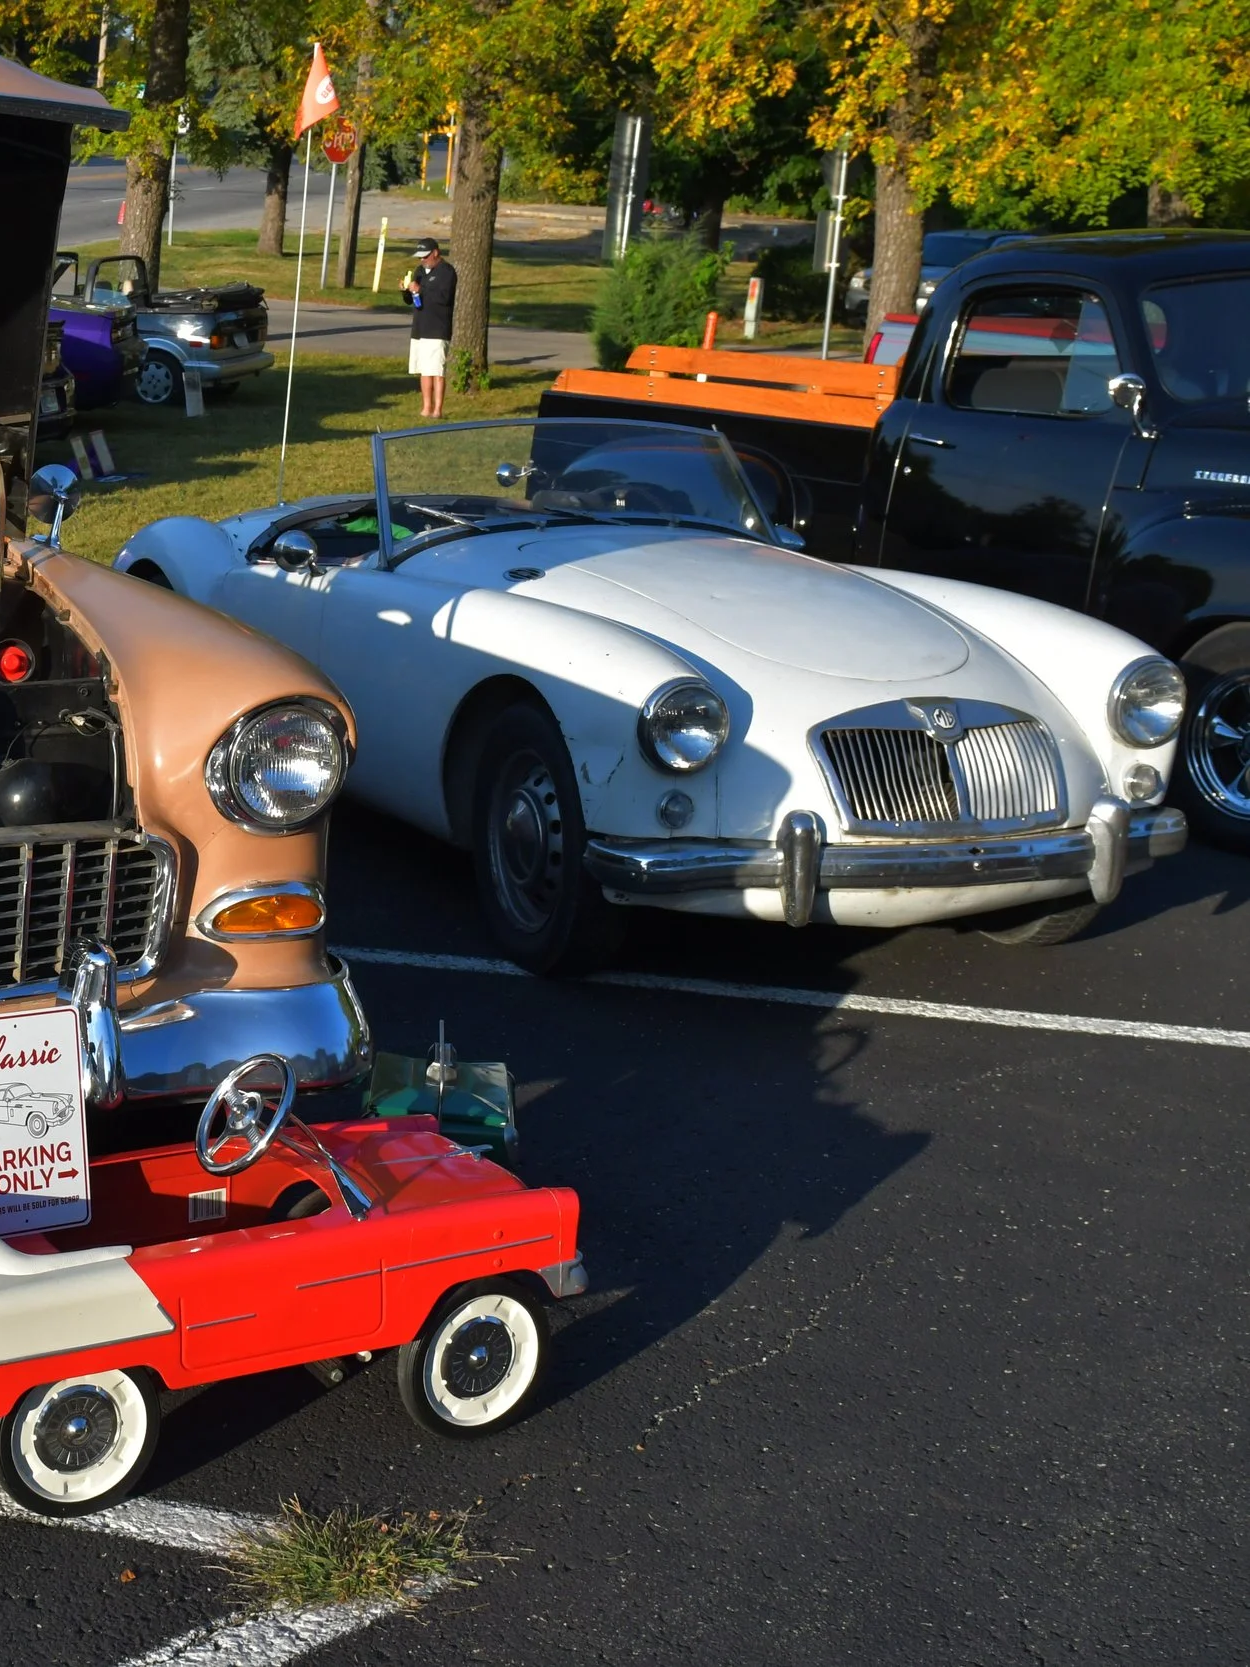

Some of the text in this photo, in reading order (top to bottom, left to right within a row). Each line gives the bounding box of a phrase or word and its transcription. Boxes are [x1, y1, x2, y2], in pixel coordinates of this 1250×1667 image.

[935, 709, 954, 728] MG
[7, 1205, 22, 1214] WILL
[23, 1203, 31, 1212] BE
[31, 1201, 47, 1210] SOLD
[48, 1198, 60, 1207] FOR
[60, 1195, 80, 1205] SCRAP
